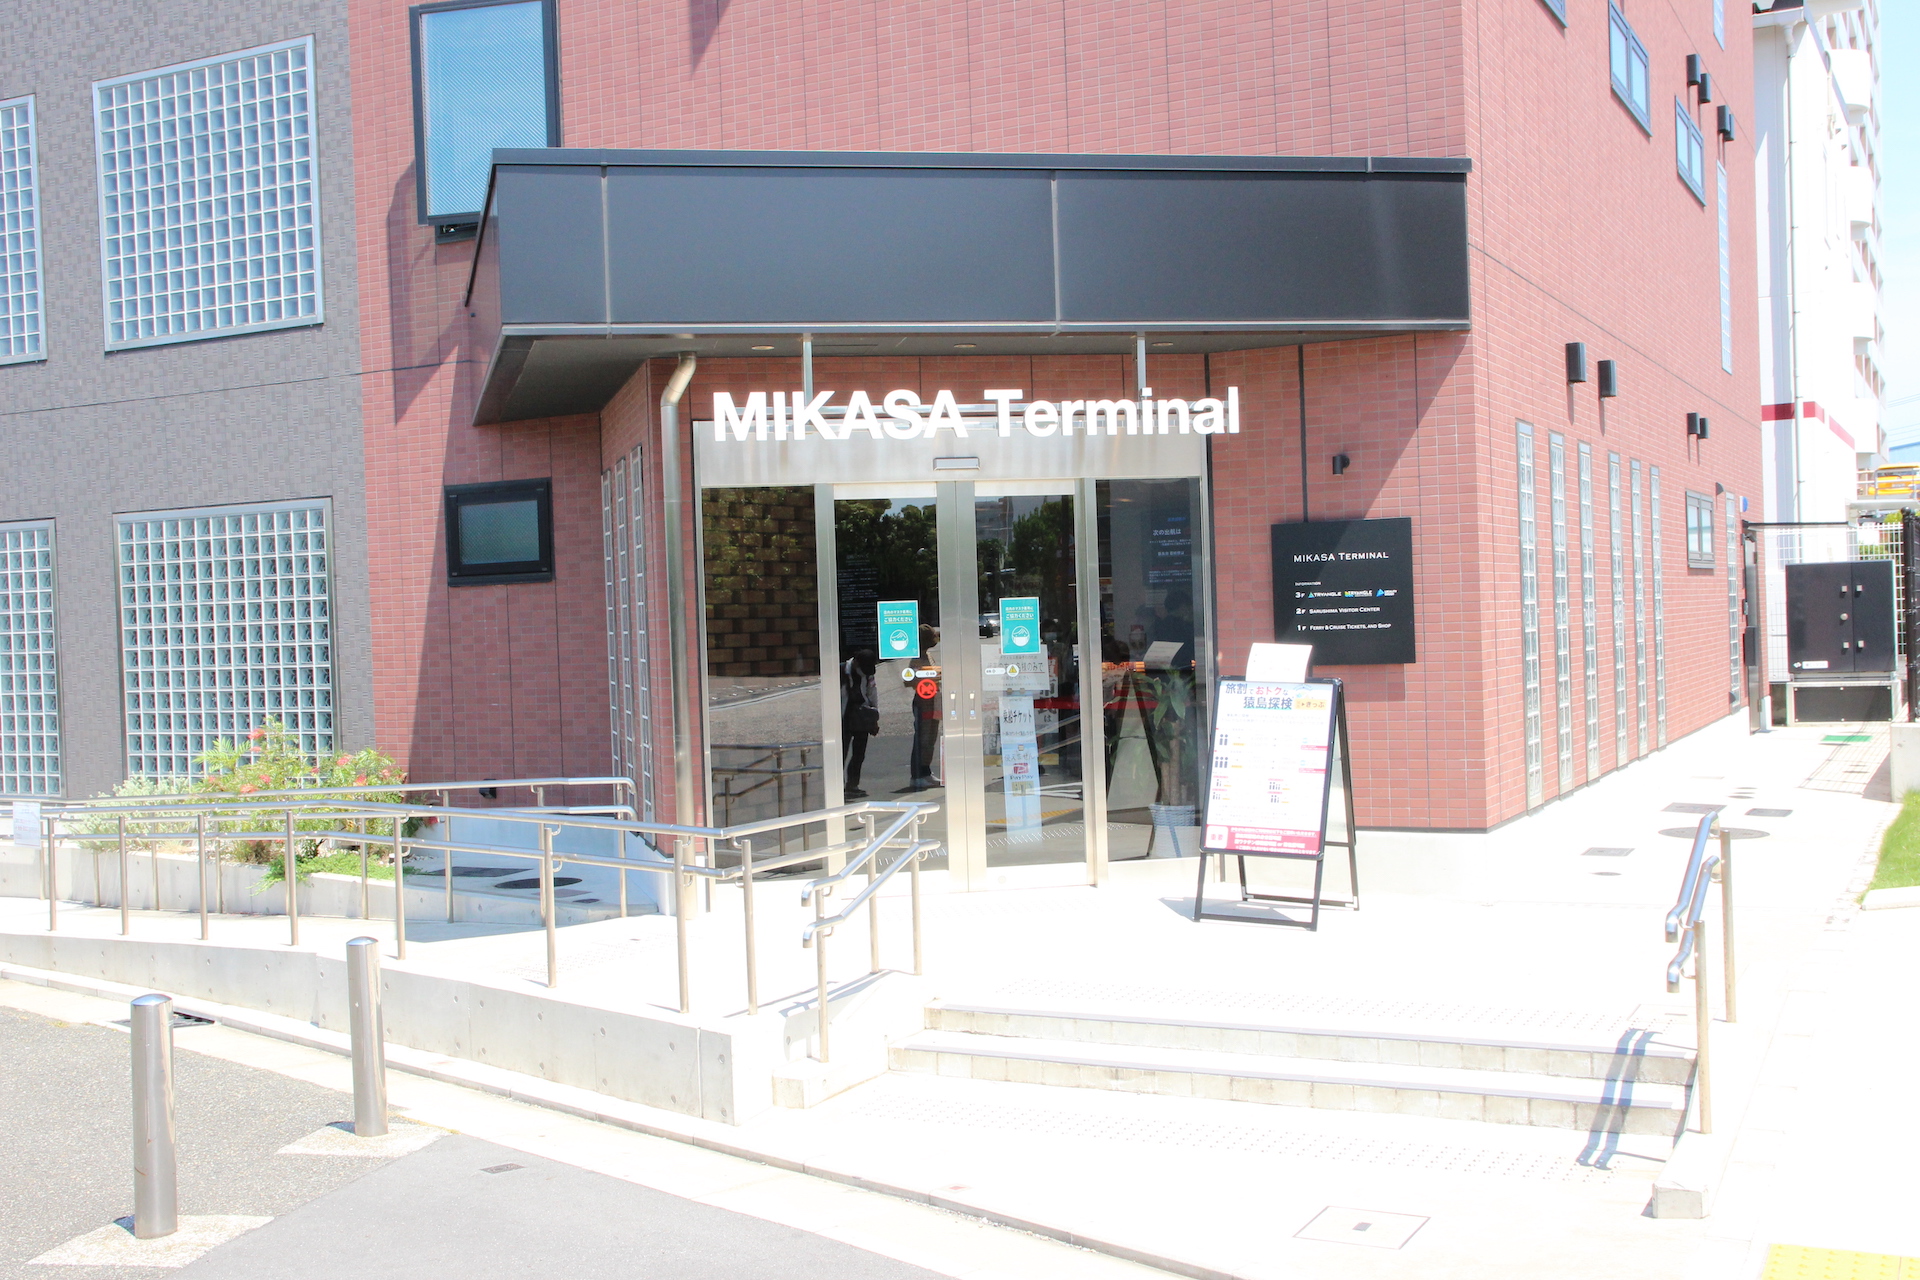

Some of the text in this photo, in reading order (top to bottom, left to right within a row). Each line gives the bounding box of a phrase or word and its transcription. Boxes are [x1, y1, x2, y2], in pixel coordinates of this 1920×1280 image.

[712, 386, 1240, 442] MIKASA Terminal
[1293, 552, 1389, 562] MIKASA TERMINAL
[1243, 696, 1293, 710] 猿島探検
